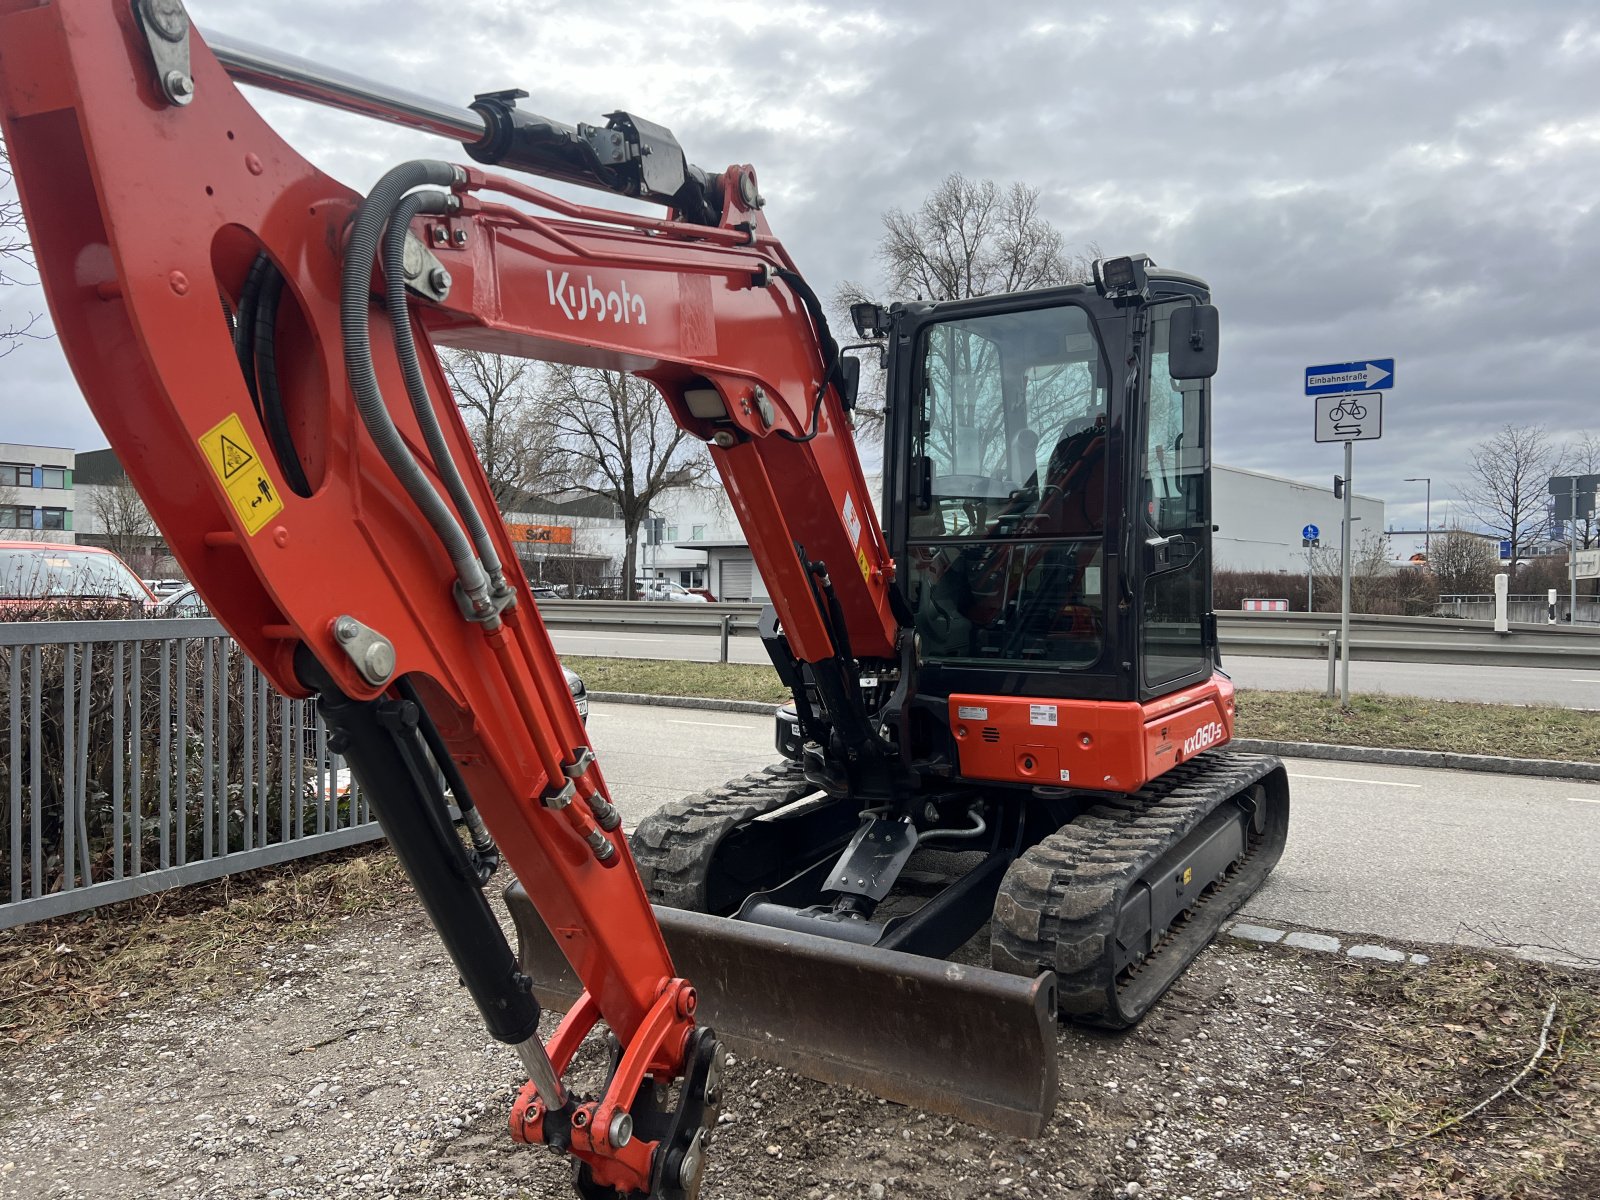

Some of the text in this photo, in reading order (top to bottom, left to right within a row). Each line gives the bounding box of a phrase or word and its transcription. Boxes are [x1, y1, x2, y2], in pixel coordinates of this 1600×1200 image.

[546, 269, 647, 325] Kubota
[1309, 372, 1368, 385] Einbahnstraße
[1183, 721, 1222, 756] KX060-5
